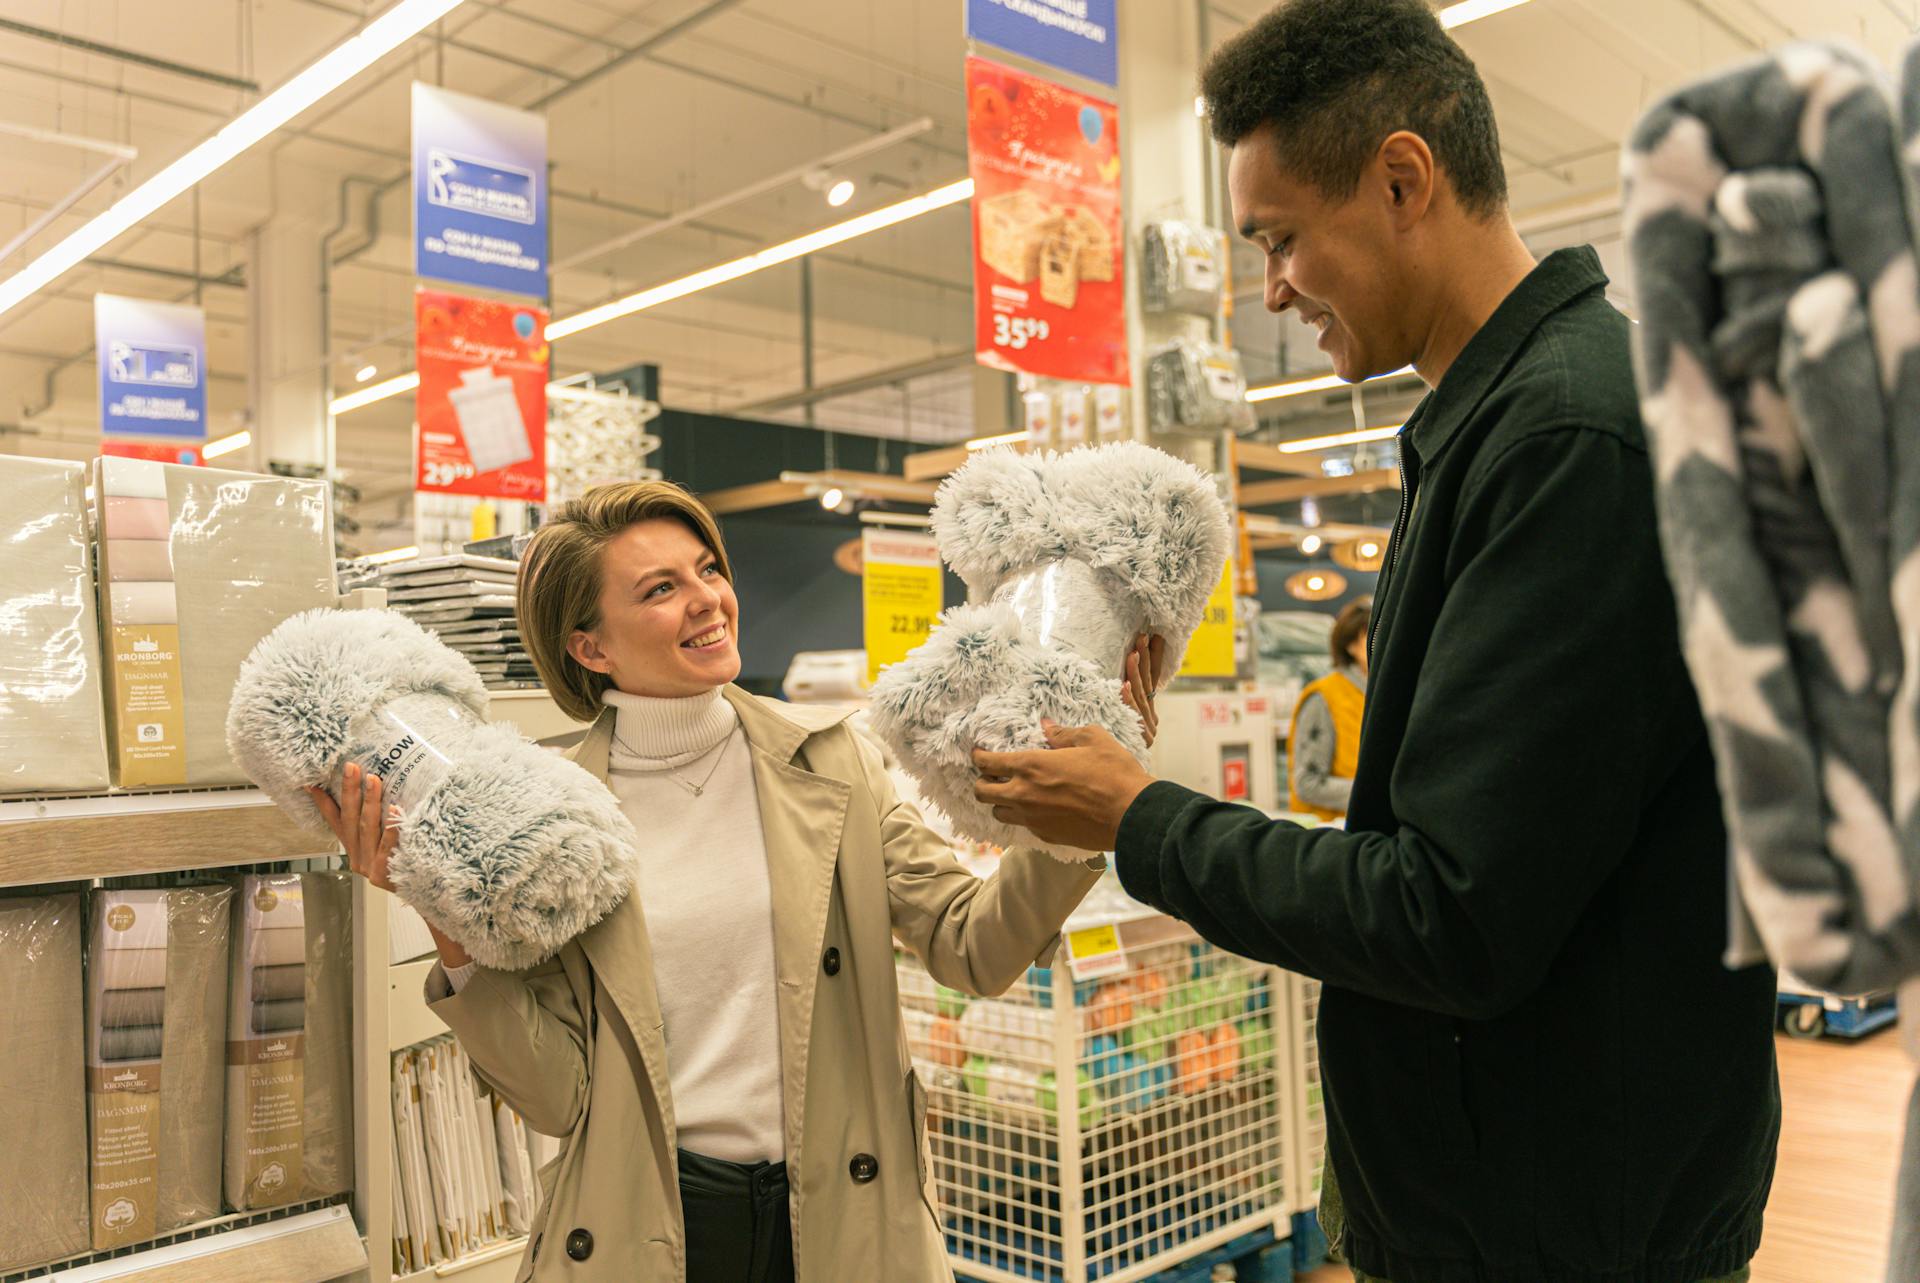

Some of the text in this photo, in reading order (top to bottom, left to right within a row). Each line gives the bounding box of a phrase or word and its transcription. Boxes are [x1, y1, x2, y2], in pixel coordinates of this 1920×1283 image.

[117, 651, 173, 661] KRONBORG
[374, 735, 415, 782] HROW
[390, 752, 427, 796] 135x195 cm
[103, 1080, 147, 1090] KRONBORG
[97, 1104, 147, 1118] DAGNMAR
[139, 1176, 152, 1184] cm
